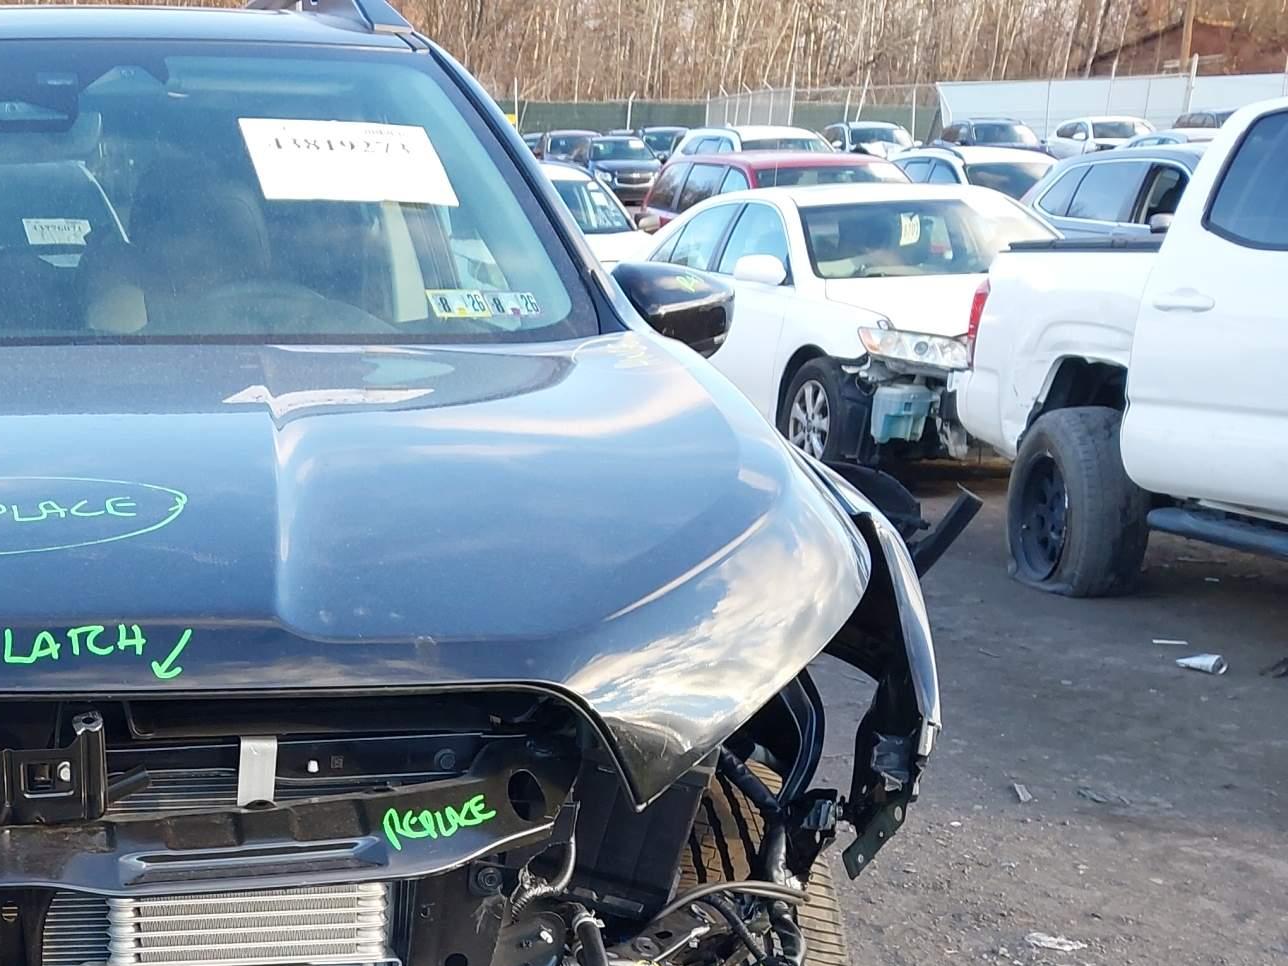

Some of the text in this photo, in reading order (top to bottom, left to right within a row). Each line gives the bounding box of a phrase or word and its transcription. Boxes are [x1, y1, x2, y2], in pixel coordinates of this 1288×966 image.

[467, 293, 486, 312] 26
[520, 294, 540, 312] 26
[3, 623, 147, 665] LATCH
